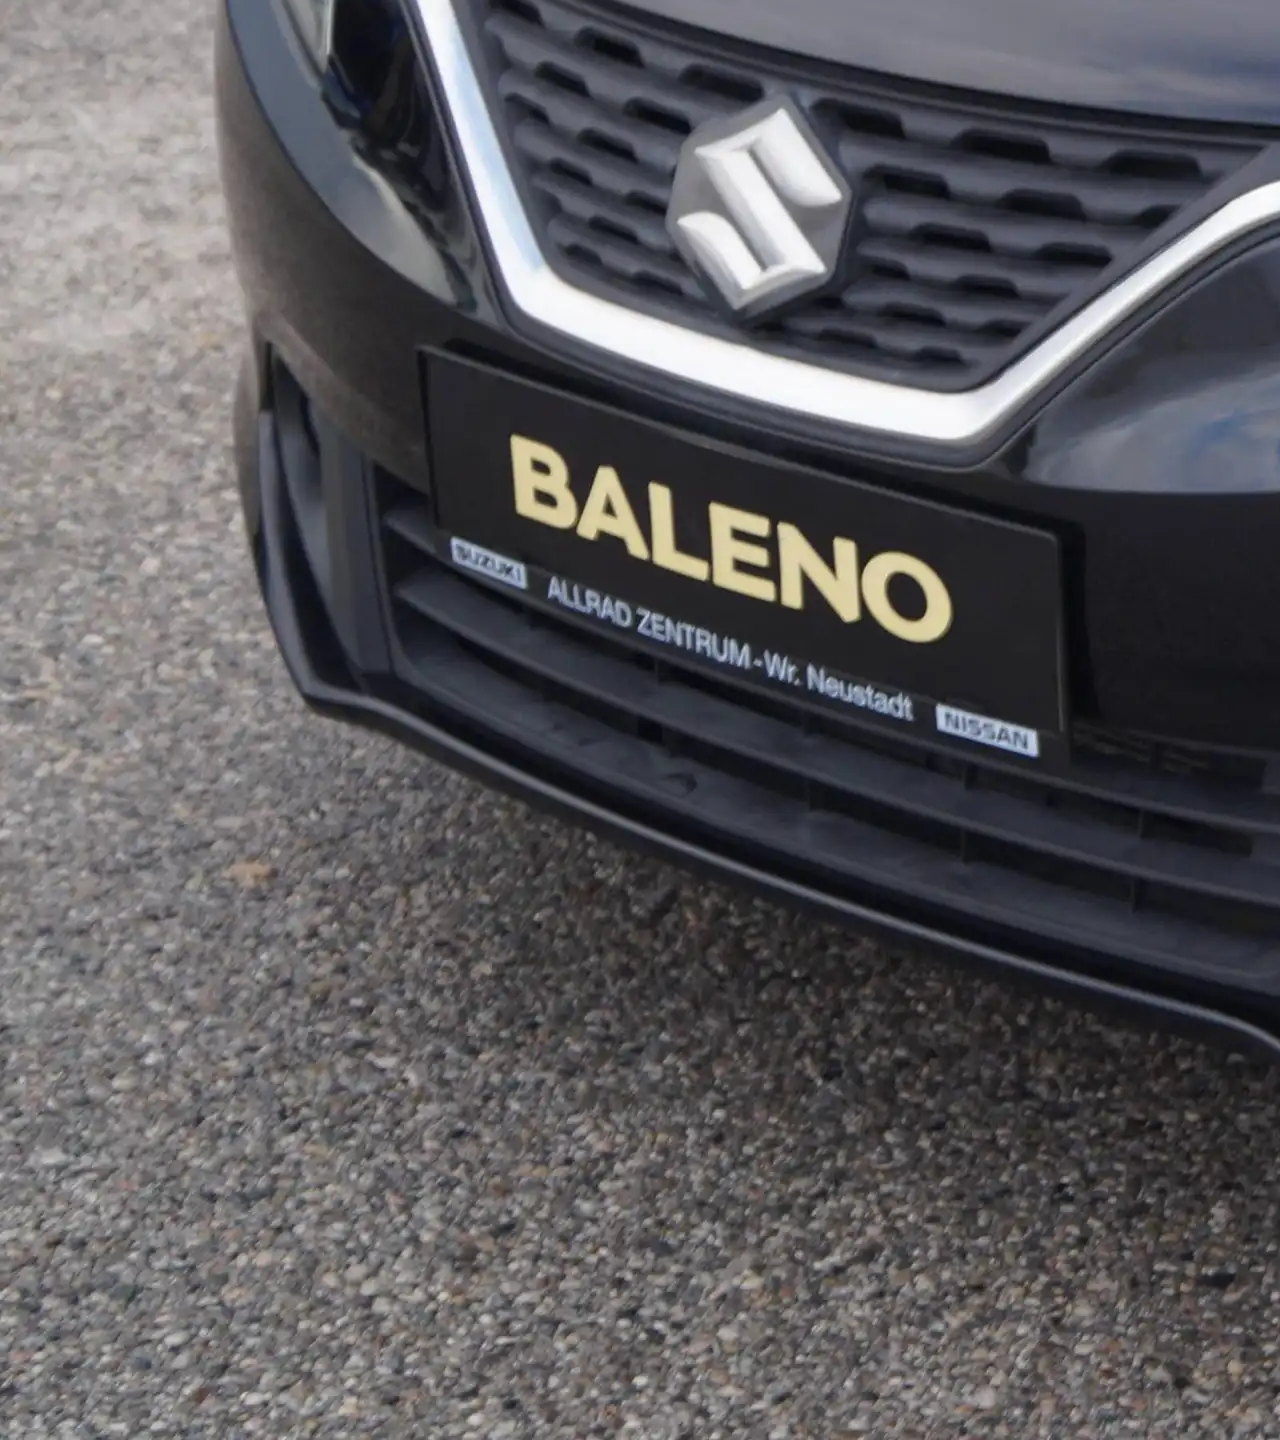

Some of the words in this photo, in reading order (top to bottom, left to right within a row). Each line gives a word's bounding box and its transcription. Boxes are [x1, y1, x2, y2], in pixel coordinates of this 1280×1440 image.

[510, 433, 953, 643] BALENO
[454, 540, 525, 586] SUZUKI
[547, 575, 633, 628] ALLRAD
[805, 662, 914, 722] Neustadt
[943, 709, 1030, 751] NISSAN
